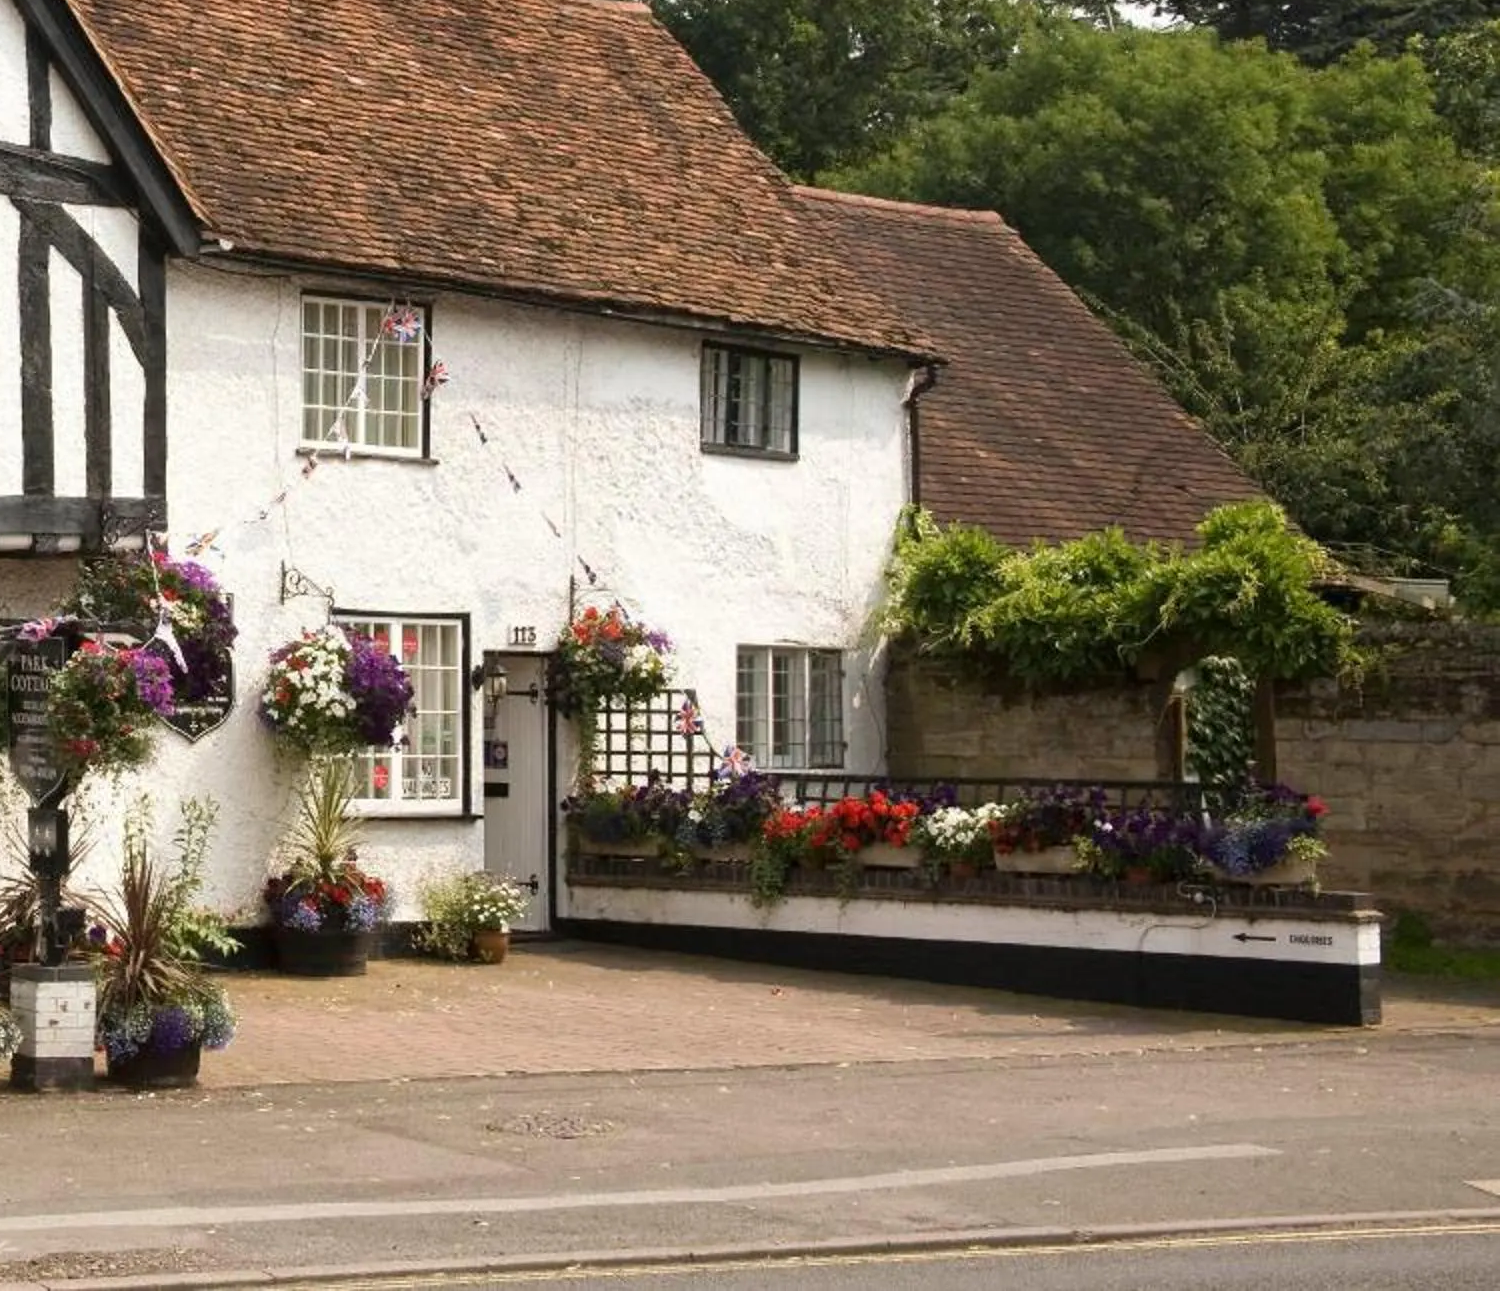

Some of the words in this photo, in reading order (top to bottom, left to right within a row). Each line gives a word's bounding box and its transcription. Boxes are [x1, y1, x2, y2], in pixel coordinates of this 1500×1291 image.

[513, 625, 537, 644] 113
[20, 654, 49, 672] PARK
[11, 674, 53, 692] COTTAG
